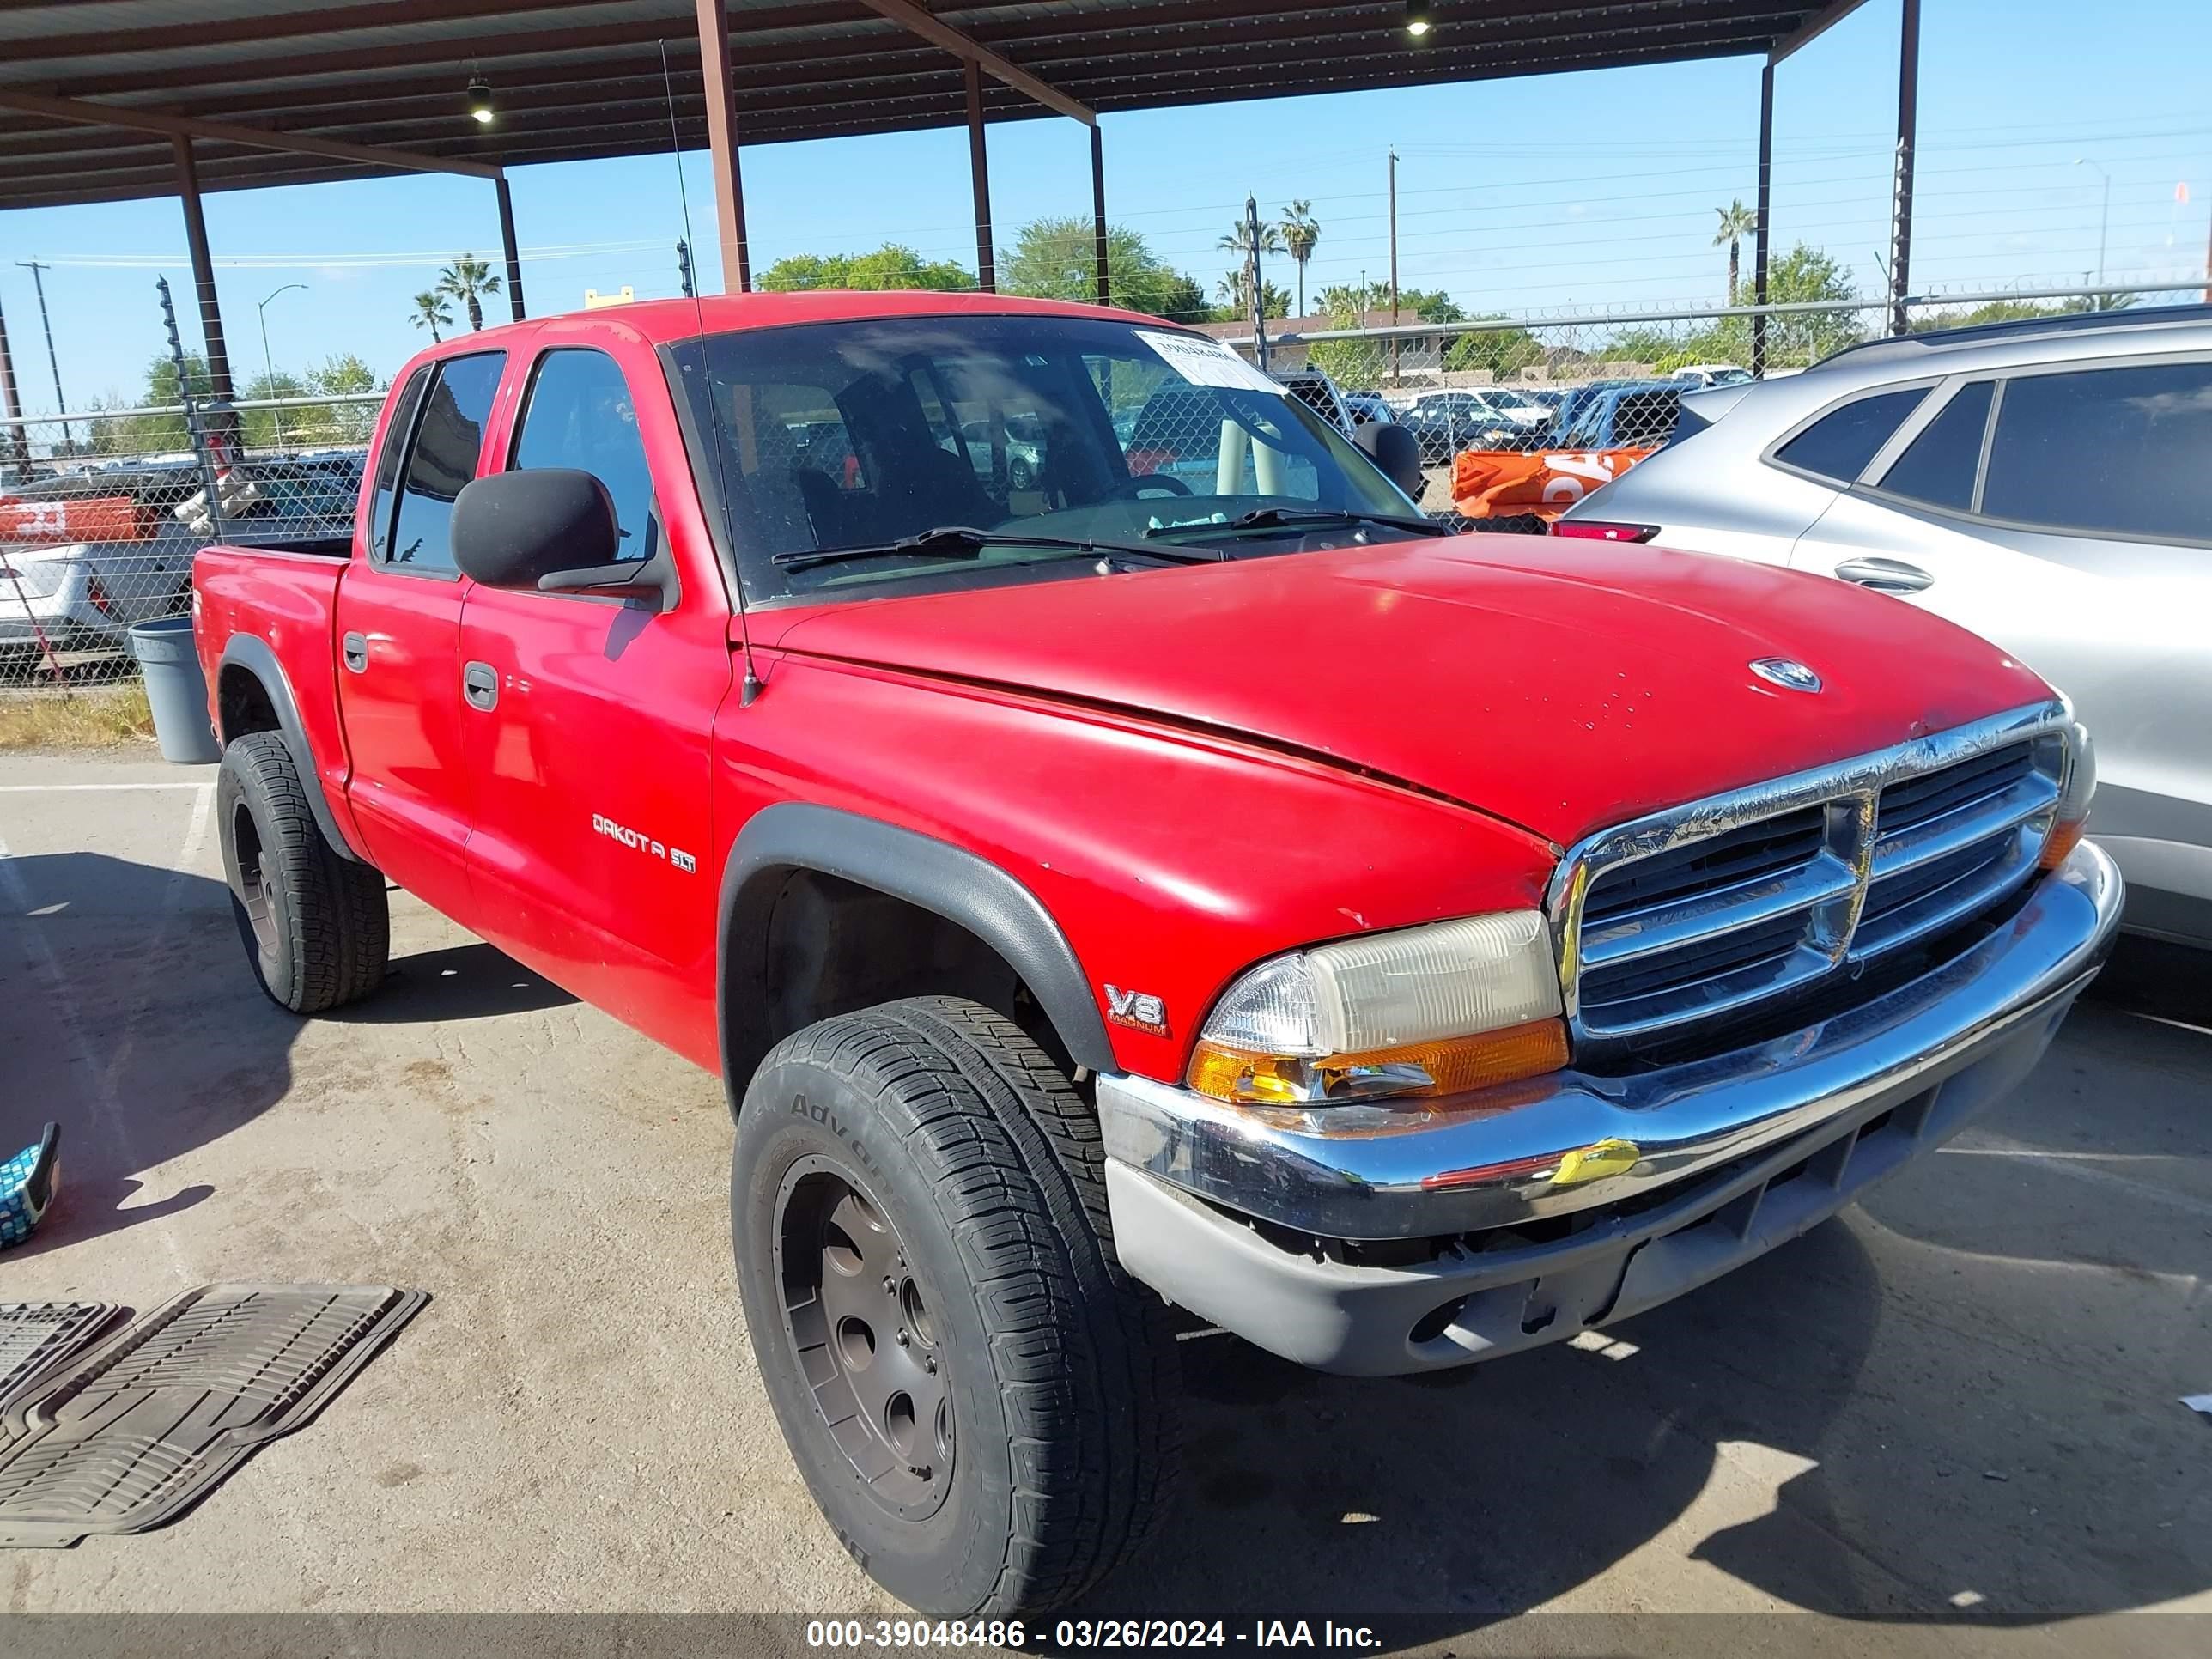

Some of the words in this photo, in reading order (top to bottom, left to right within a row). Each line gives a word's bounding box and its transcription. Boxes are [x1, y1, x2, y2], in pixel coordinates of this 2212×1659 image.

[592, 812, 665, 860] DAKOTA
[671, 848, 696, 873] SLT
[1103, 983, 1166, 1025] V8
[1109, 1012, 1167, 1036] MAGNUM
